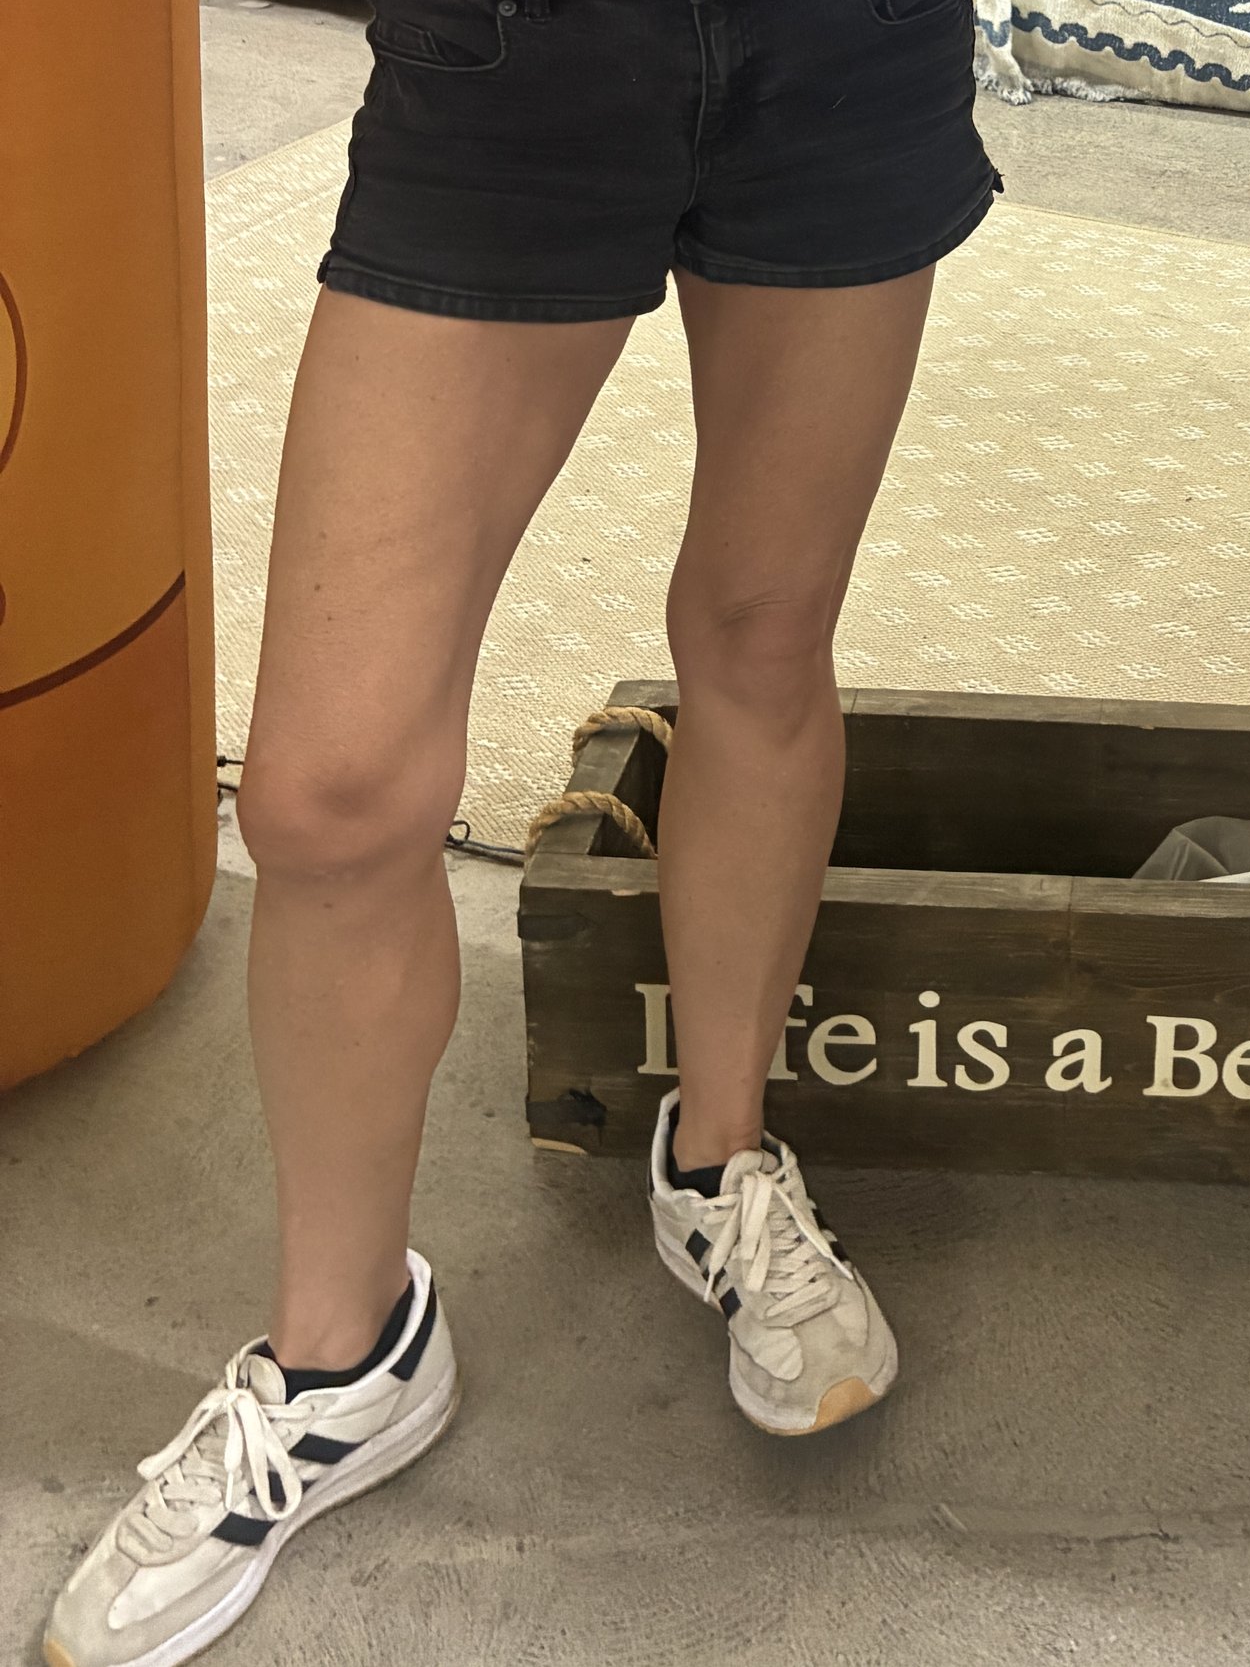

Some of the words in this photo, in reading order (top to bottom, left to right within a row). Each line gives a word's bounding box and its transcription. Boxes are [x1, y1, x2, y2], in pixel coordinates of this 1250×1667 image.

[634, 983, 877, 1085] Lfe
[907, 990, 1010, 1091] is
[1045, 1028, 1112, 1093] a
